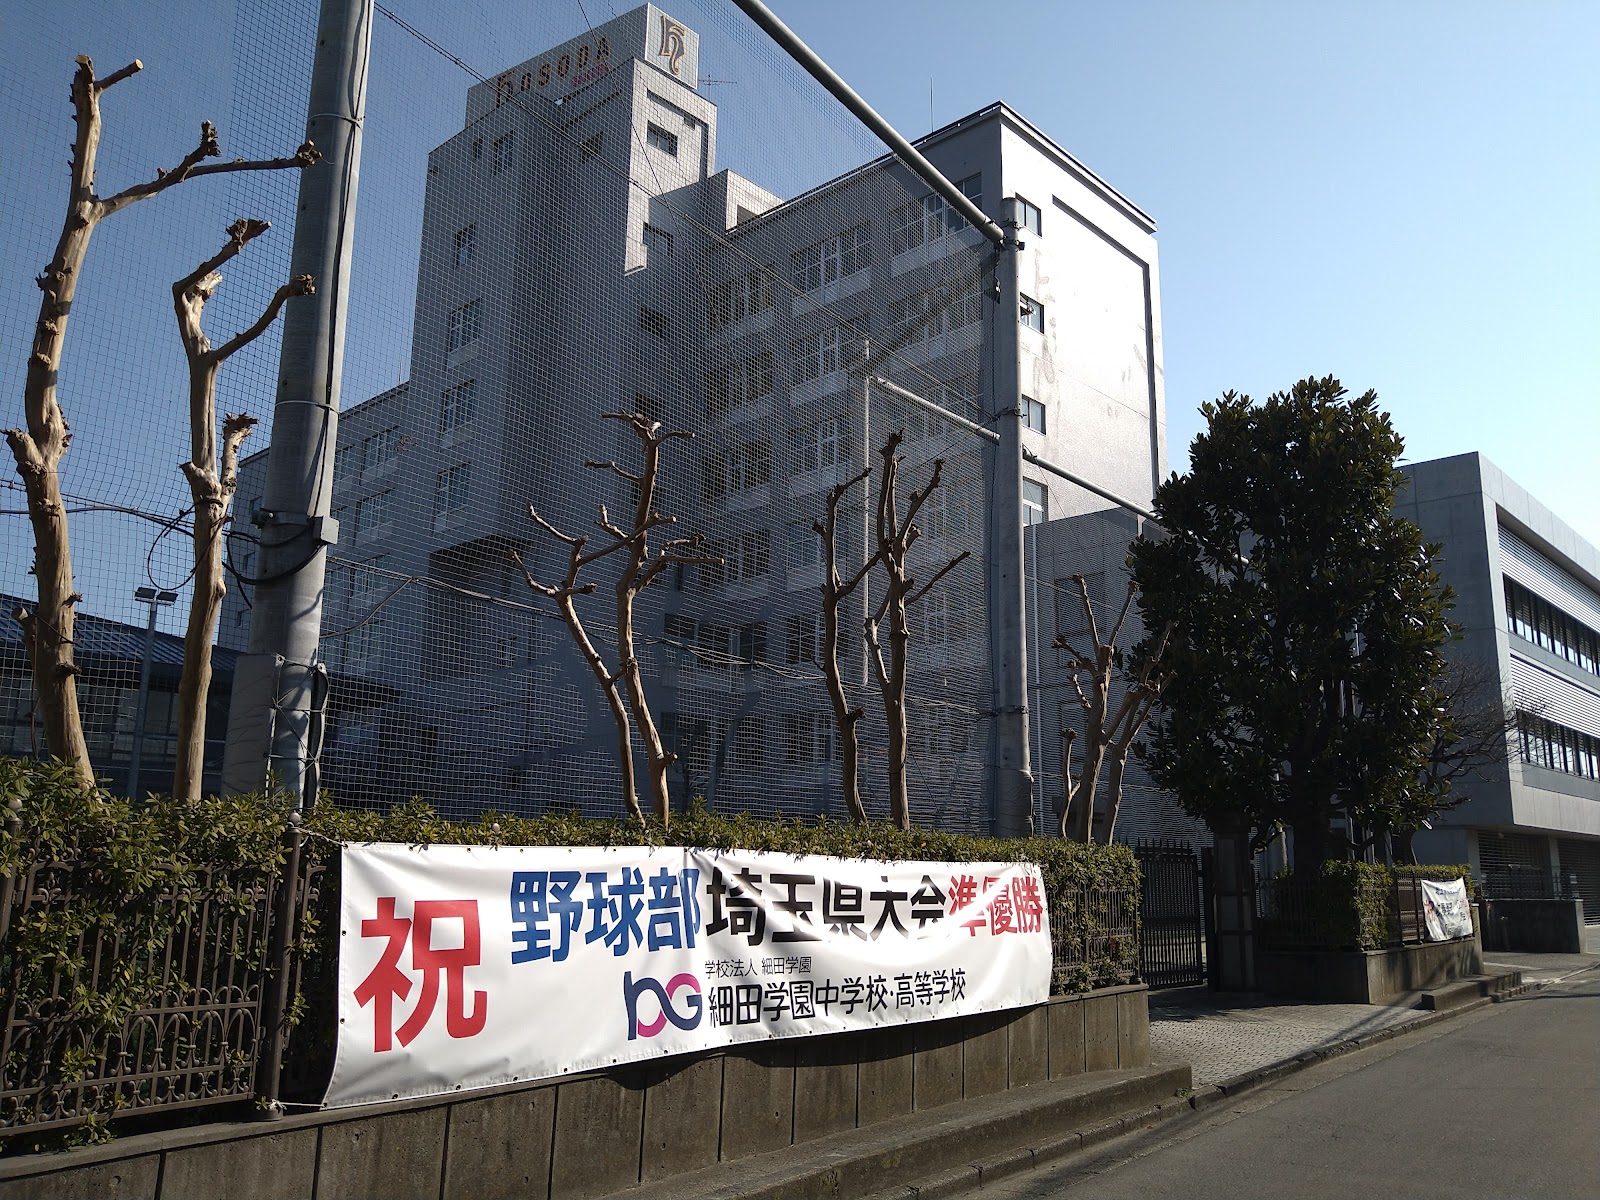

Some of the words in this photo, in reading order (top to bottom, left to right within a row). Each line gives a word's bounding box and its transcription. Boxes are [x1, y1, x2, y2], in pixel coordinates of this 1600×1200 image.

[353, 896, 488, 1053] 祝
[705, 957, 758, 979] 学校法人
[761, 955, 812, 976] 細田学園
